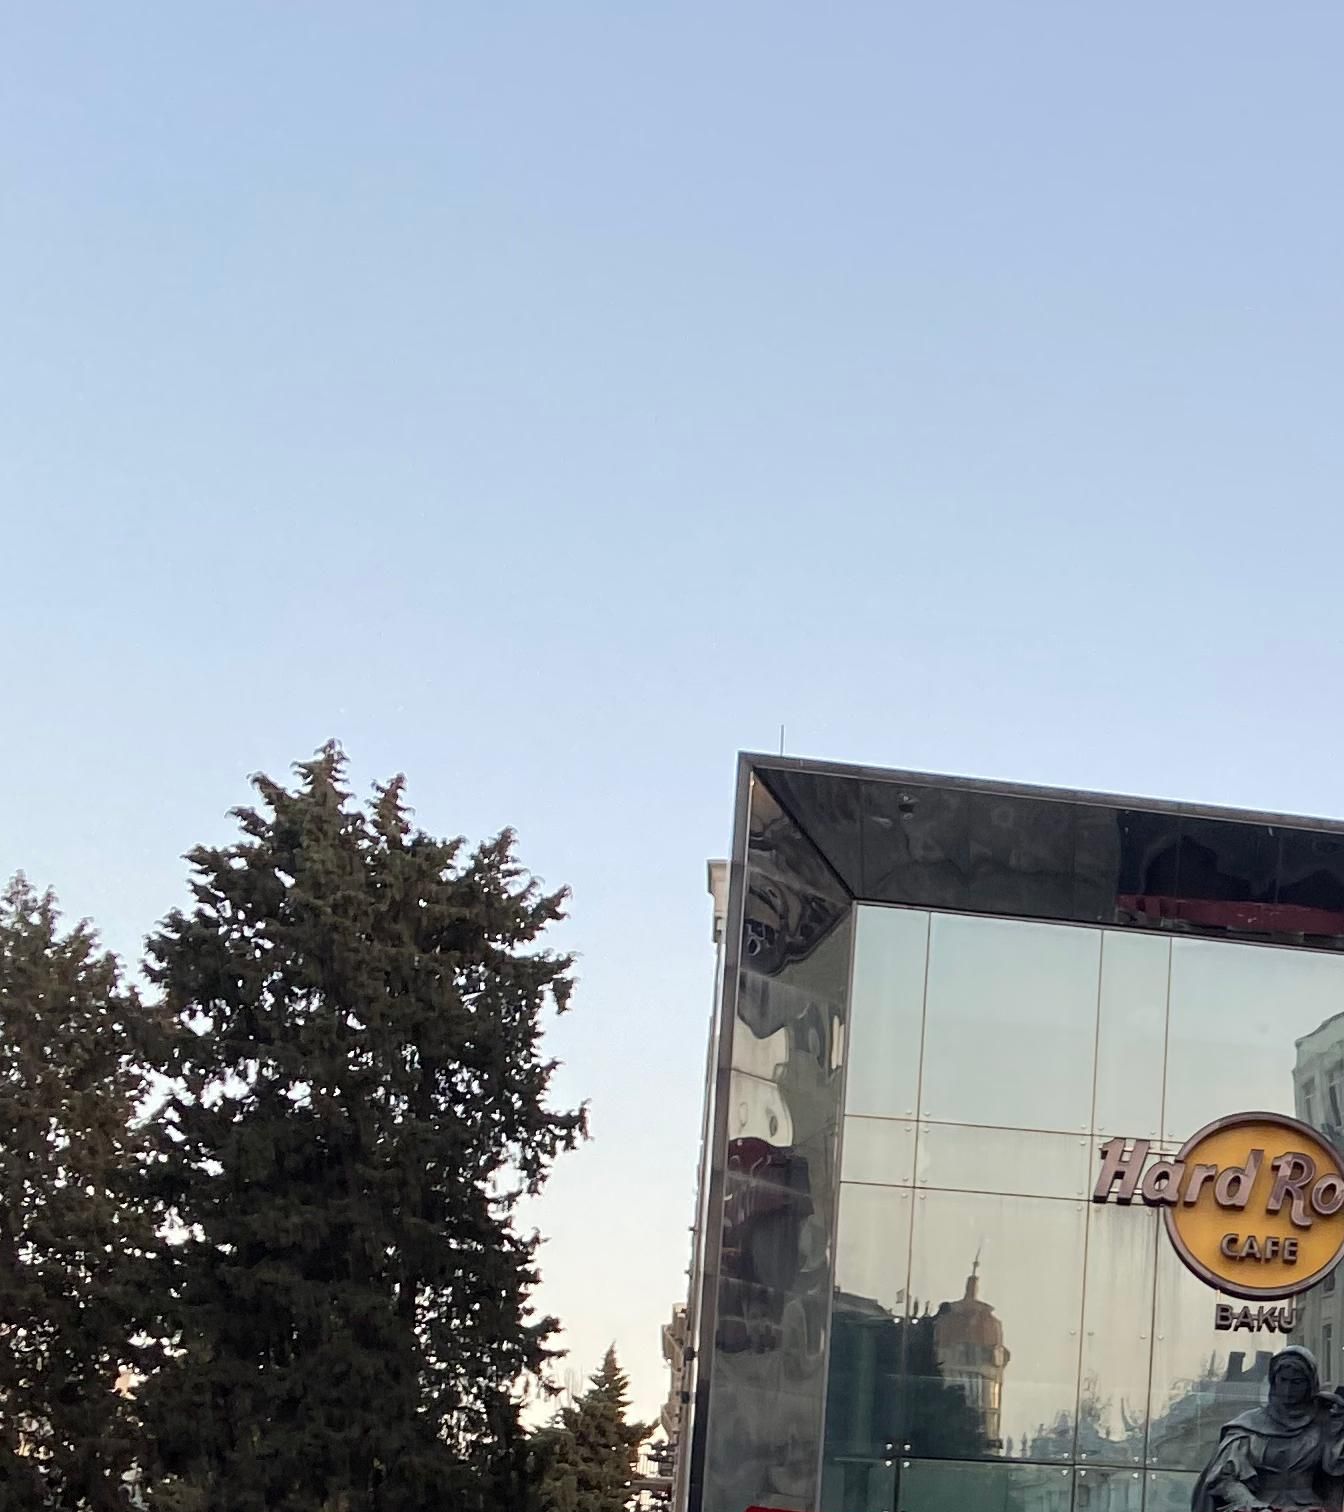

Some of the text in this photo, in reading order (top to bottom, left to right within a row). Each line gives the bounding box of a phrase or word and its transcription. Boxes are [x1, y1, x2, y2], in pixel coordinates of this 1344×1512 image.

[1093, 1137, 1265, 1210] Hard
[1220, 1232, 1299, 1265] CAFE
[1214, 1303, 1297, 1333] BAKU
